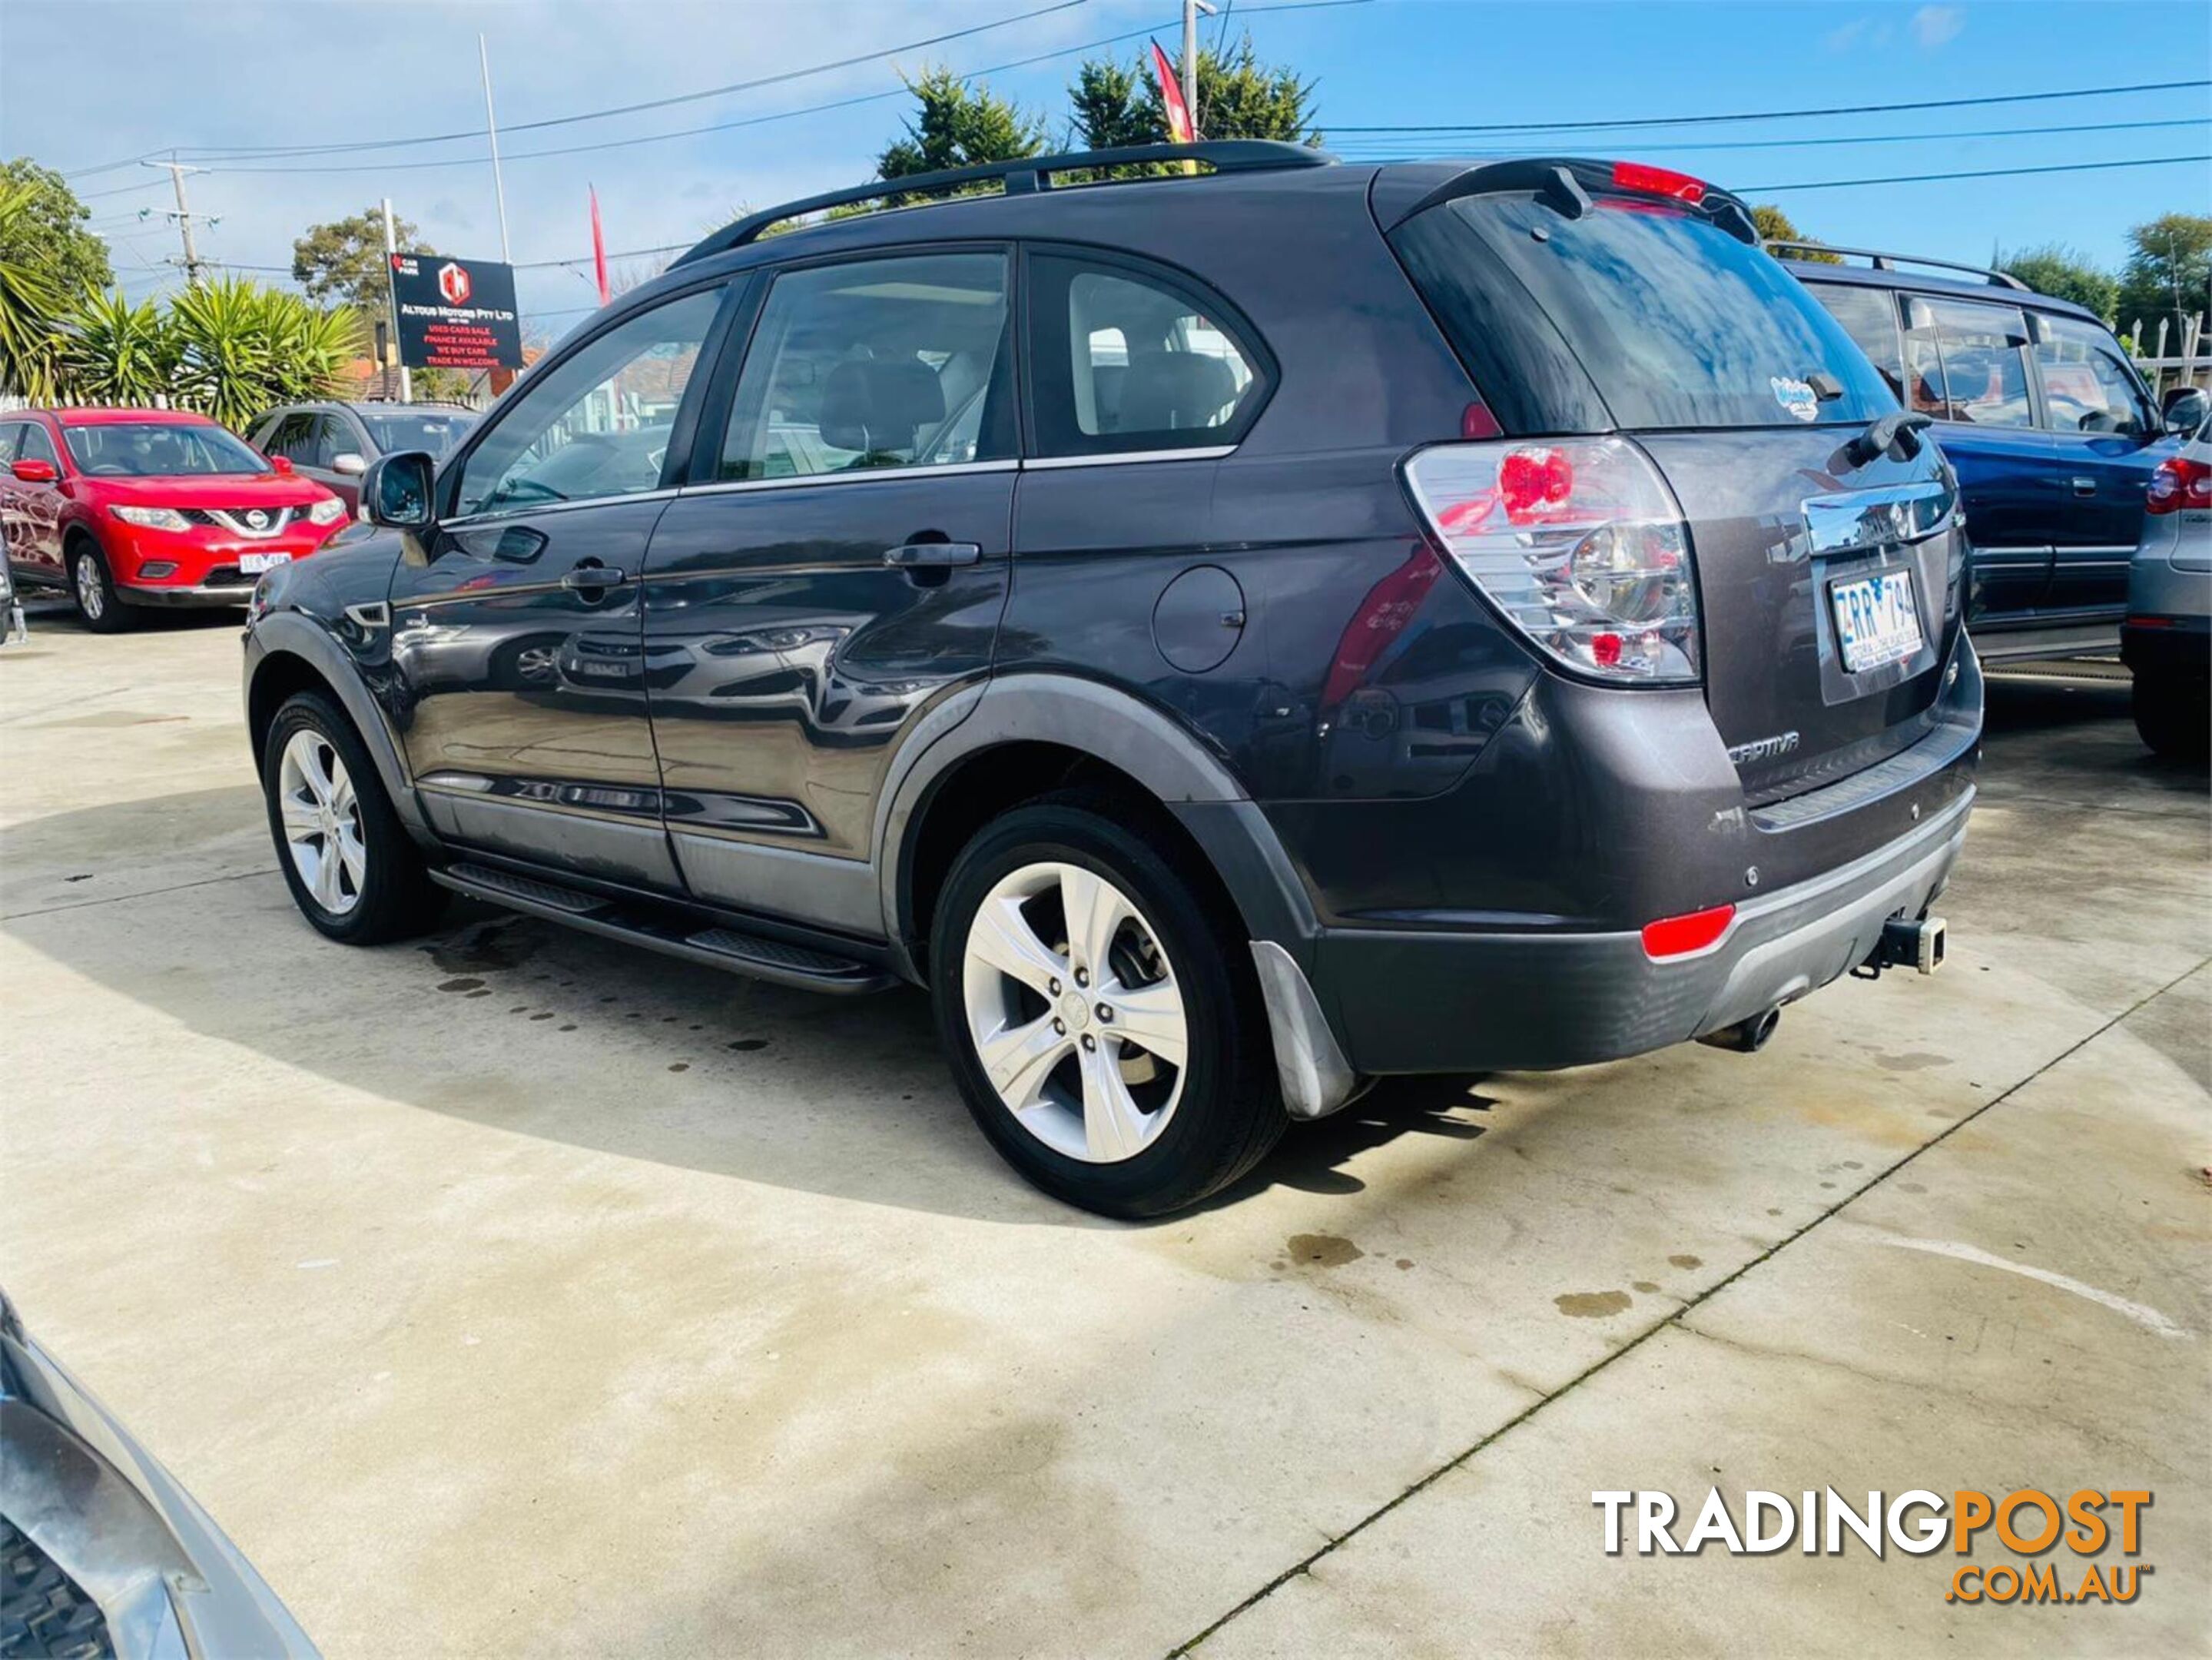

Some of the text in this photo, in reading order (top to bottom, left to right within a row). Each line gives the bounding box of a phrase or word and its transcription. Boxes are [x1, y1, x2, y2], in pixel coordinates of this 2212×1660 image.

[402, 258, 418, 267] CAR
[399, 267, 420, 275] PARK
[429, 324, 449, 333] USED
[449, 326, 470, 334] CARS
[424, 335, 498, 346] FINANCE AVAILABLE
[466, 347, 487, 356] CARS
[426, 356, 452, 365] TRADE
[1835, 587, 1878, 644] ZRR
[1728, 731, 1799, 764] CAPTIVA
